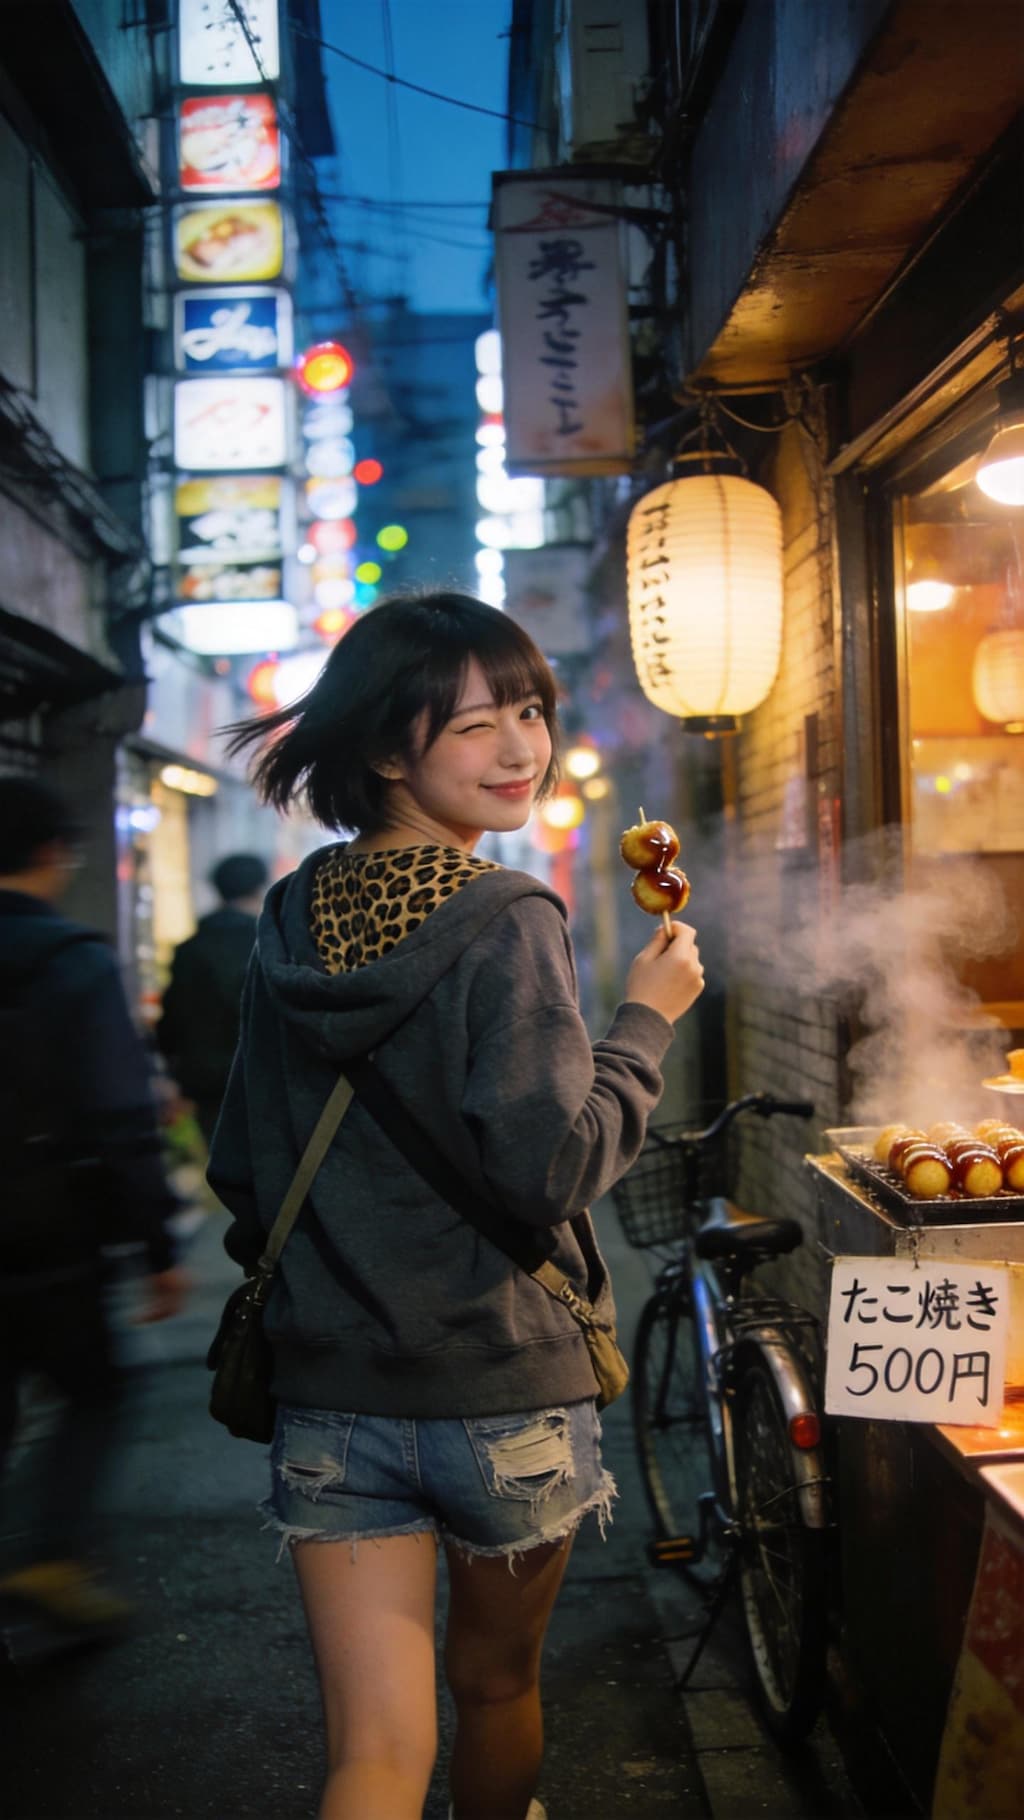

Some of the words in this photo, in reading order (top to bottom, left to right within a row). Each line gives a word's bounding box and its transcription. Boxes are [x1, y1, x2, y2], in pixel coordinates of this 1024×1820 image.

[841, 1278, 999, 1331] たこ焼き
[845, 1342, 991, 1407] 500円
